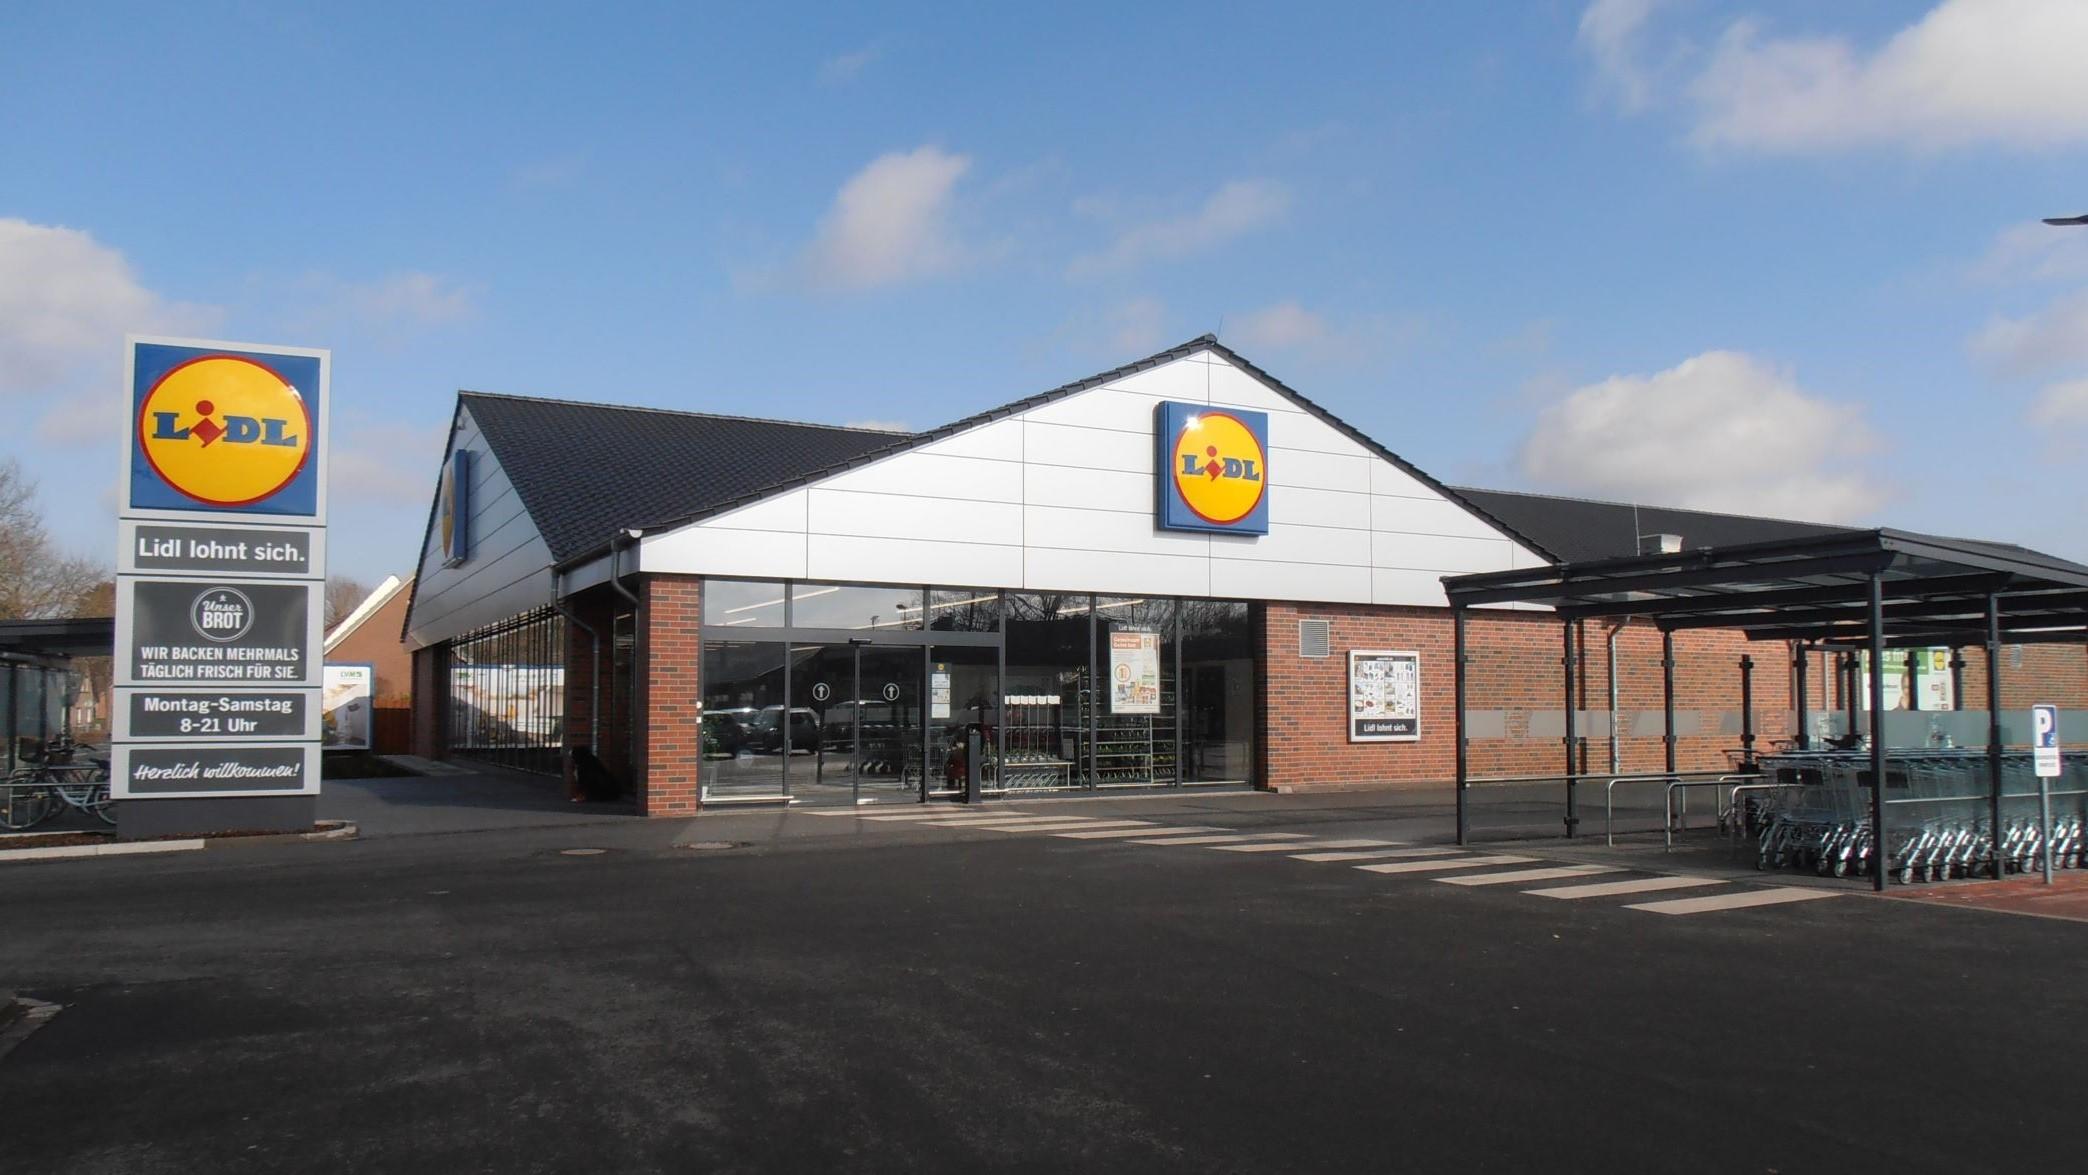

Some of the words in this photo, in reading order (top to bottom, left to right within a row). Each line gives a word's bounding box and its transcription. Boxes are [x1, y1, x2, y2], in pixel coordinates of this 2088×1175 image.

[138, 537, 181, 558] Lidl
[189, 540, 247, 560] lohnt
[254, 542, 306, 563] sich.
[202, 600, 243, 612] Unser
[202, 611, 244, 629] BROT
[141, 646, 168, 660] WIR
[172, 647, 223, 660] BACKEN
[226, 648, 299, 661] MEHRMALS
[140, 662, 193, 678] TÄGLICH
[197, 665, 243, 678] FRISCH
[246, 663, 271, 678] FÜR
[274, 666, 299, 679] SIE.
[180, 718, 220, 733] 8-21
[228, 718, 258, 732] Uhr
[1363, 723, 1376, 732] Lidl
[2034, 708, 2053, 747] P
[133, 762, 199, 780] Herzlich
[202, 762, 300, 779] willkommen!
